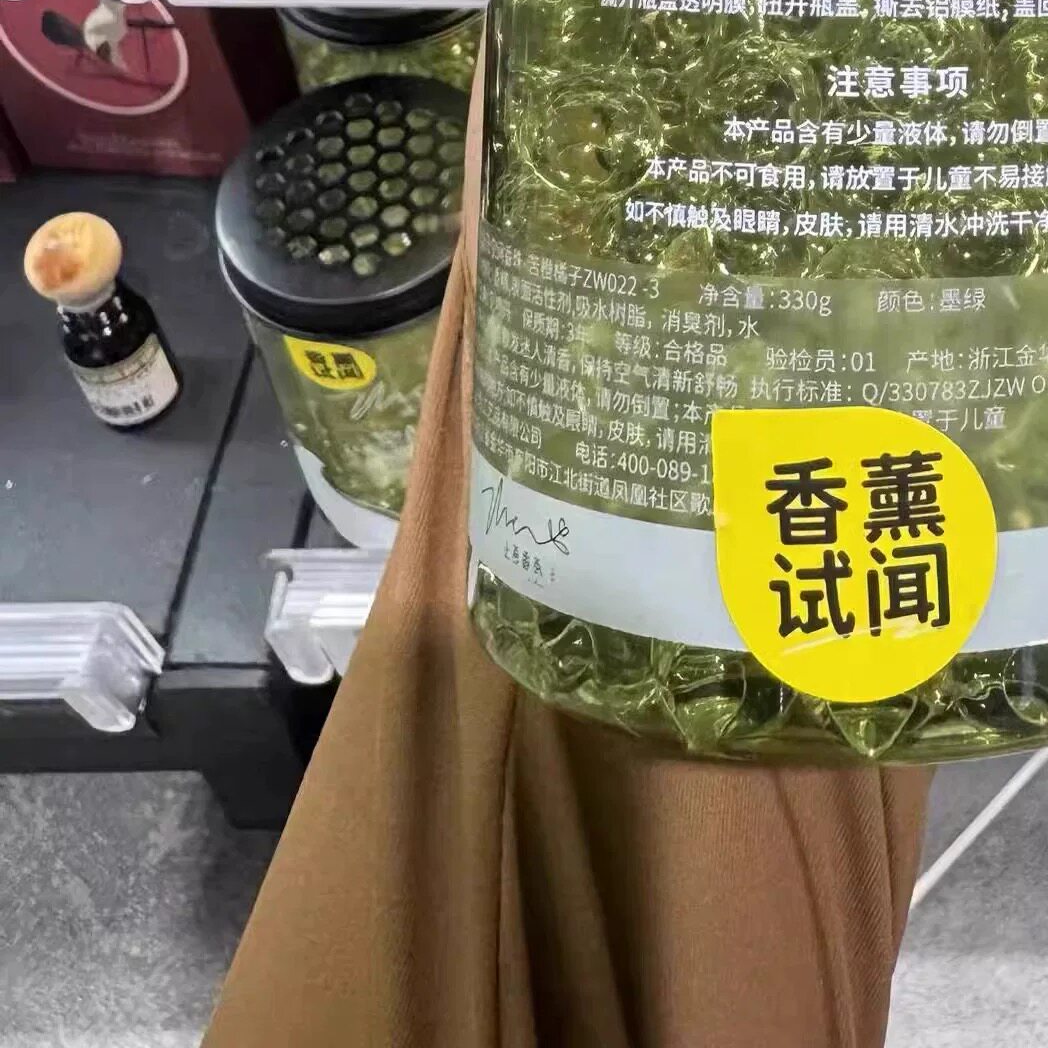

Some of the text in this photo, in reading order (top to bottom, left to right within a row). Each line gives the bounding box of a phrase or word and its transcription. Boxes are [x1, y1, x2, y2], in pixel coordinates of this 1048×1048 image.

[828, 65, 970, 99] 注意事项
[765, 451, 946, 546] 香薰
[769, 542, 951, 638] 试闻
